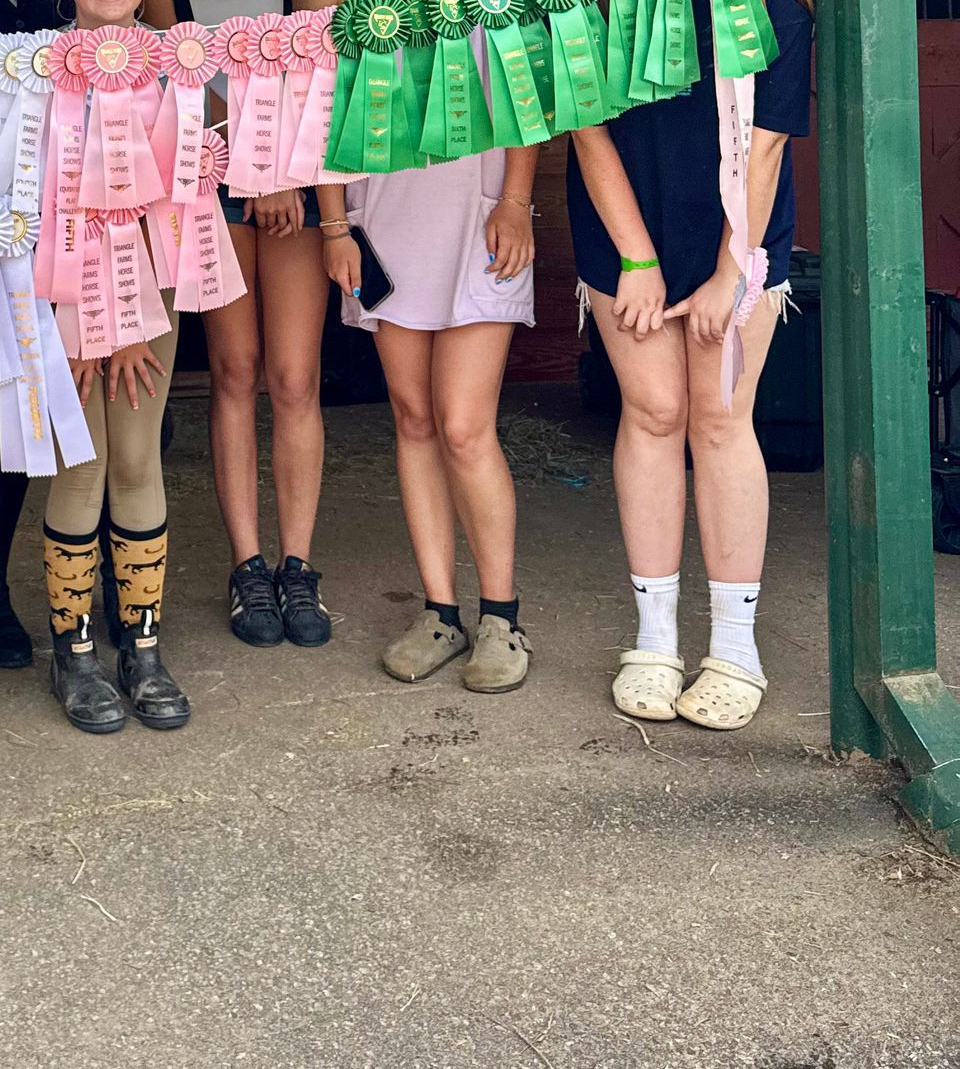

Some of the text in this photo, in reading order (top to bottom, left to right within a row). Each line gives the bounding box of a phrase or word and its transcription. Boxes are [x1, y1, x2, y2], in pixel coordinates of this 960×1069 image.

[255, 98, 276, 107] TRIANGLE
[22, 113, 42, 124] TRIANGLE
[256, 114, 272, 122] FARMS
[104, 119, 128, 128] TRIANGLE
[255, 130, 272, 138] HORSE
[21, 138, 36, 146] HORSE
[730, 104, 738, 177] FIFTH
[64, 146, 80, 154] HORSE
[181, 144, 197, 153] HORSE
[254, 145, 272, 153] SHOWS
[179, 160, 195, 168] SHOWS
[194, 212, 214, 223] TRIANGLE
[65, 219, 75, 252] FIFTH
[199, 236, 214, 245] HORSE
[113, 243, 135, 252] TRIANGLE
[200, 247, 215, 257] SHOWS
[117, 255, 133, 264] FARMS
[118, 267, 134, 275] HORSE
[118, 278, 135, 288] SHOWS
[203, 276, 217, 285] FIFTH
[82, 283, 99, 291] HORSE
[203, 287, 219, 296] PLACE
[82, 294, 102, 303] SHOWS
[121, 310, 136, 318] FIFTH
[86, 325, 104, 333] FIFTH
[121, 321, 139, 330] PLACE
[86, 336, 106, 344] PLACE
